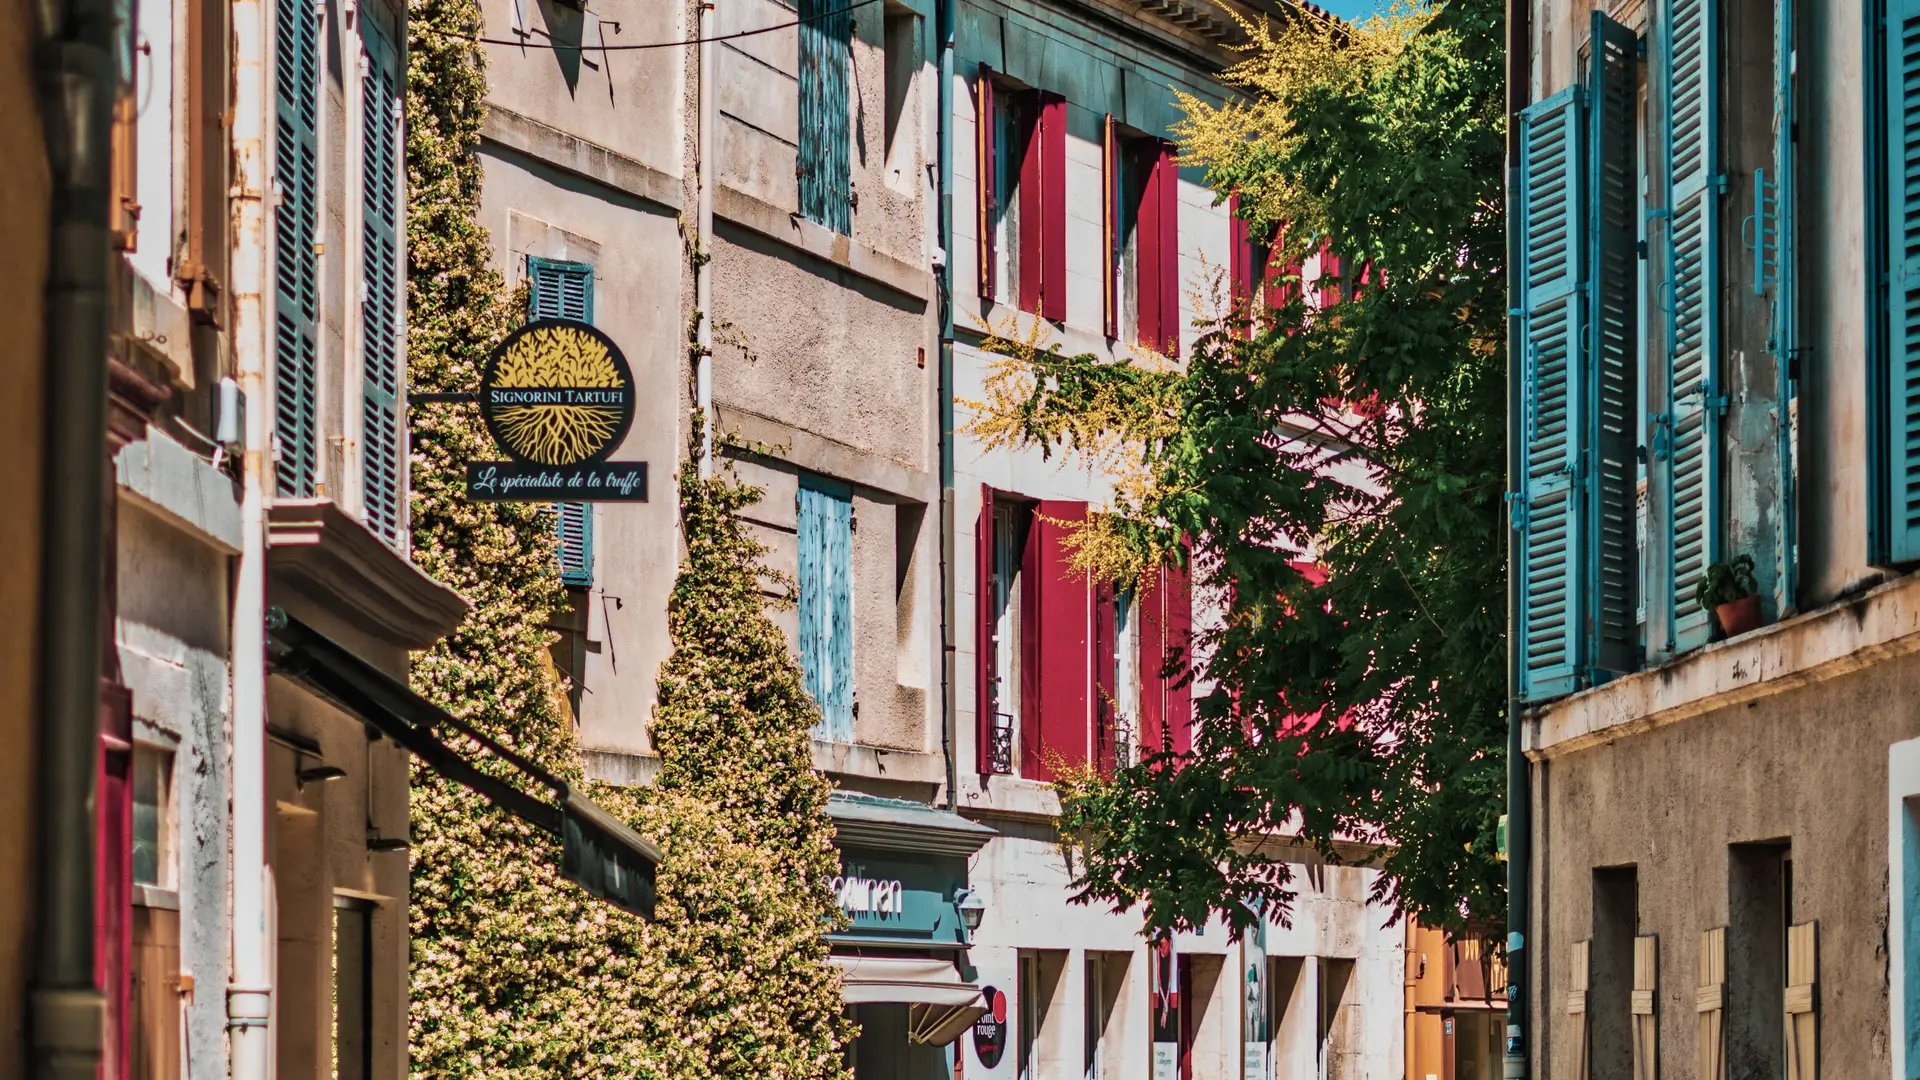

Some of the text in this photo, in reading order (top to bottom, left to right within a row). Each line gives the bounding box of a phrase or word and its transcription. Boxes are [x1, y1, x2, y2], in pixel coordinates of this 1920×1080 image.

[491, 390, 623, 403] SIGNORINI TARTUFI
[473, 466, 641, 495] Le spécialiste de la truffe
[977, 1011, 995, 1024] oint
[977, 1025, 996, 1039] rouge
